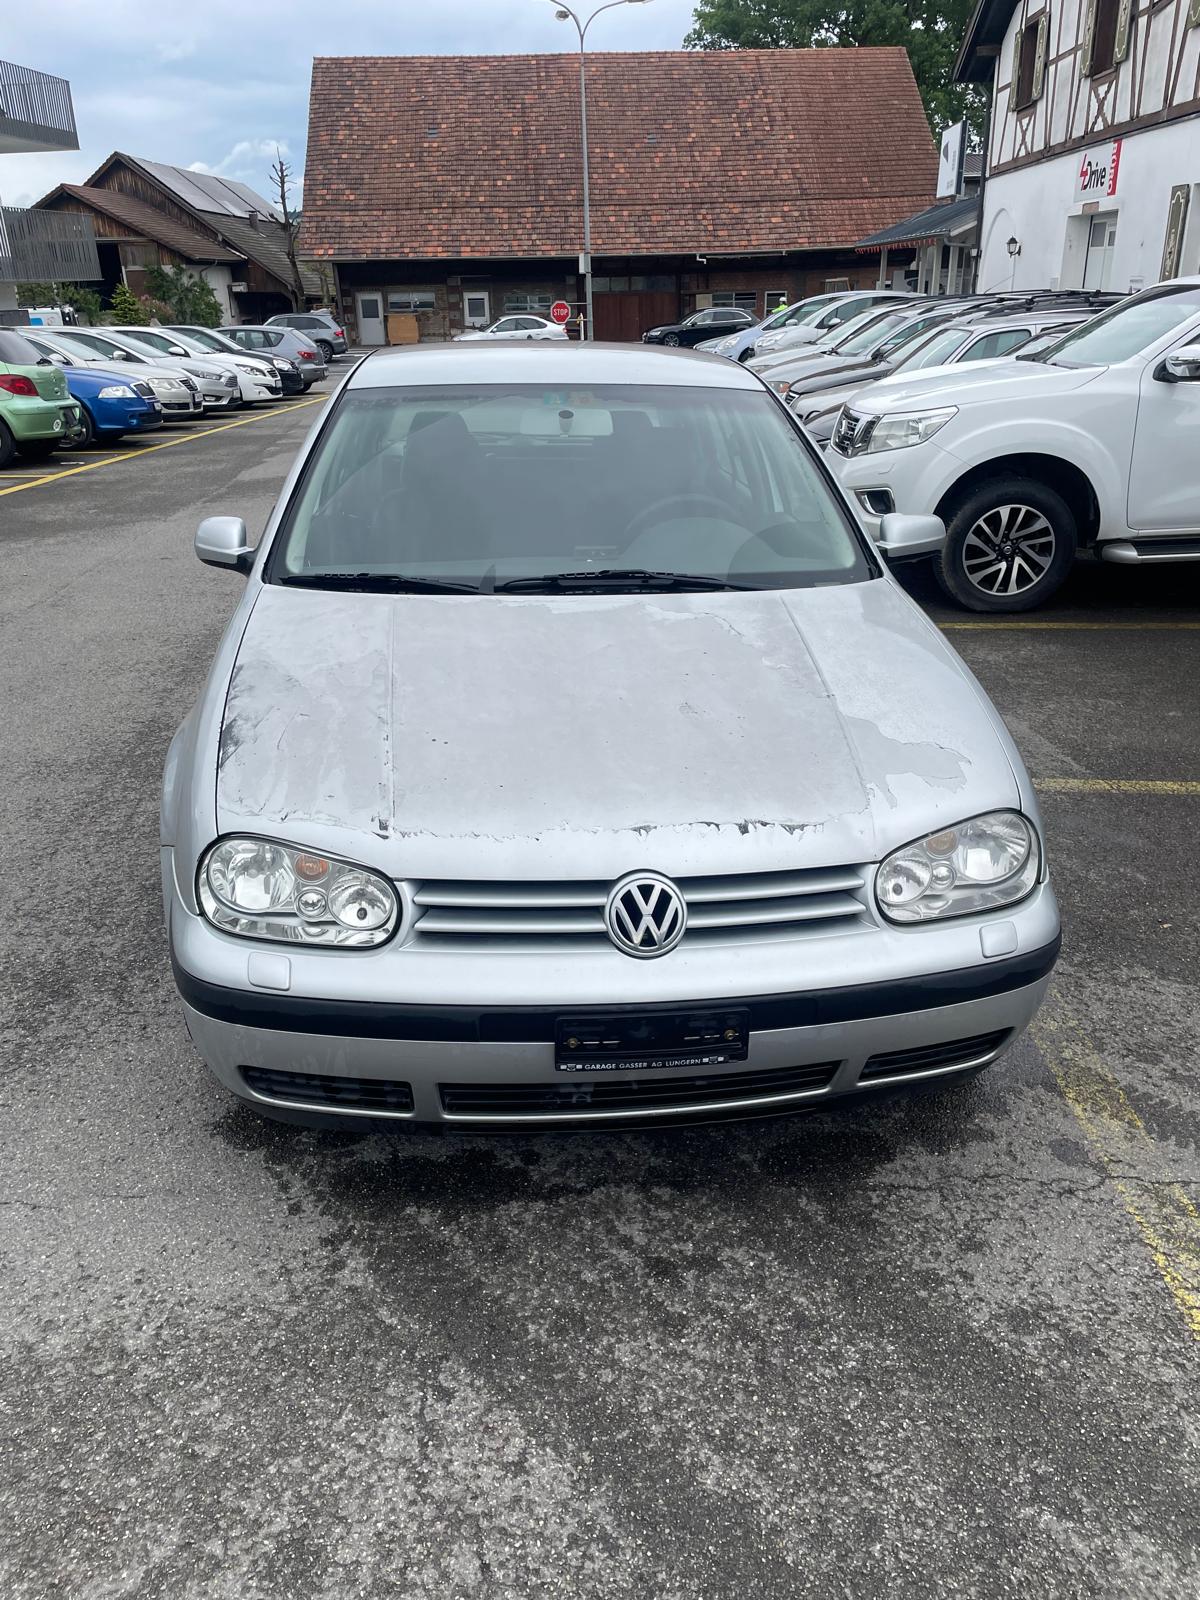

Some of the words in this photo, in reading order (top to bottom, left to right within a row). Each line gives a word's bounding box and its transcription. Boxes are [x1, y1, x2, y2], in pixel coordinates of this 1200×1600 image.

[553, 308, 568, 316] STOP
[609, 876, 684, 952] VW
[665, 1058, 701, 1067] LUNGERN
